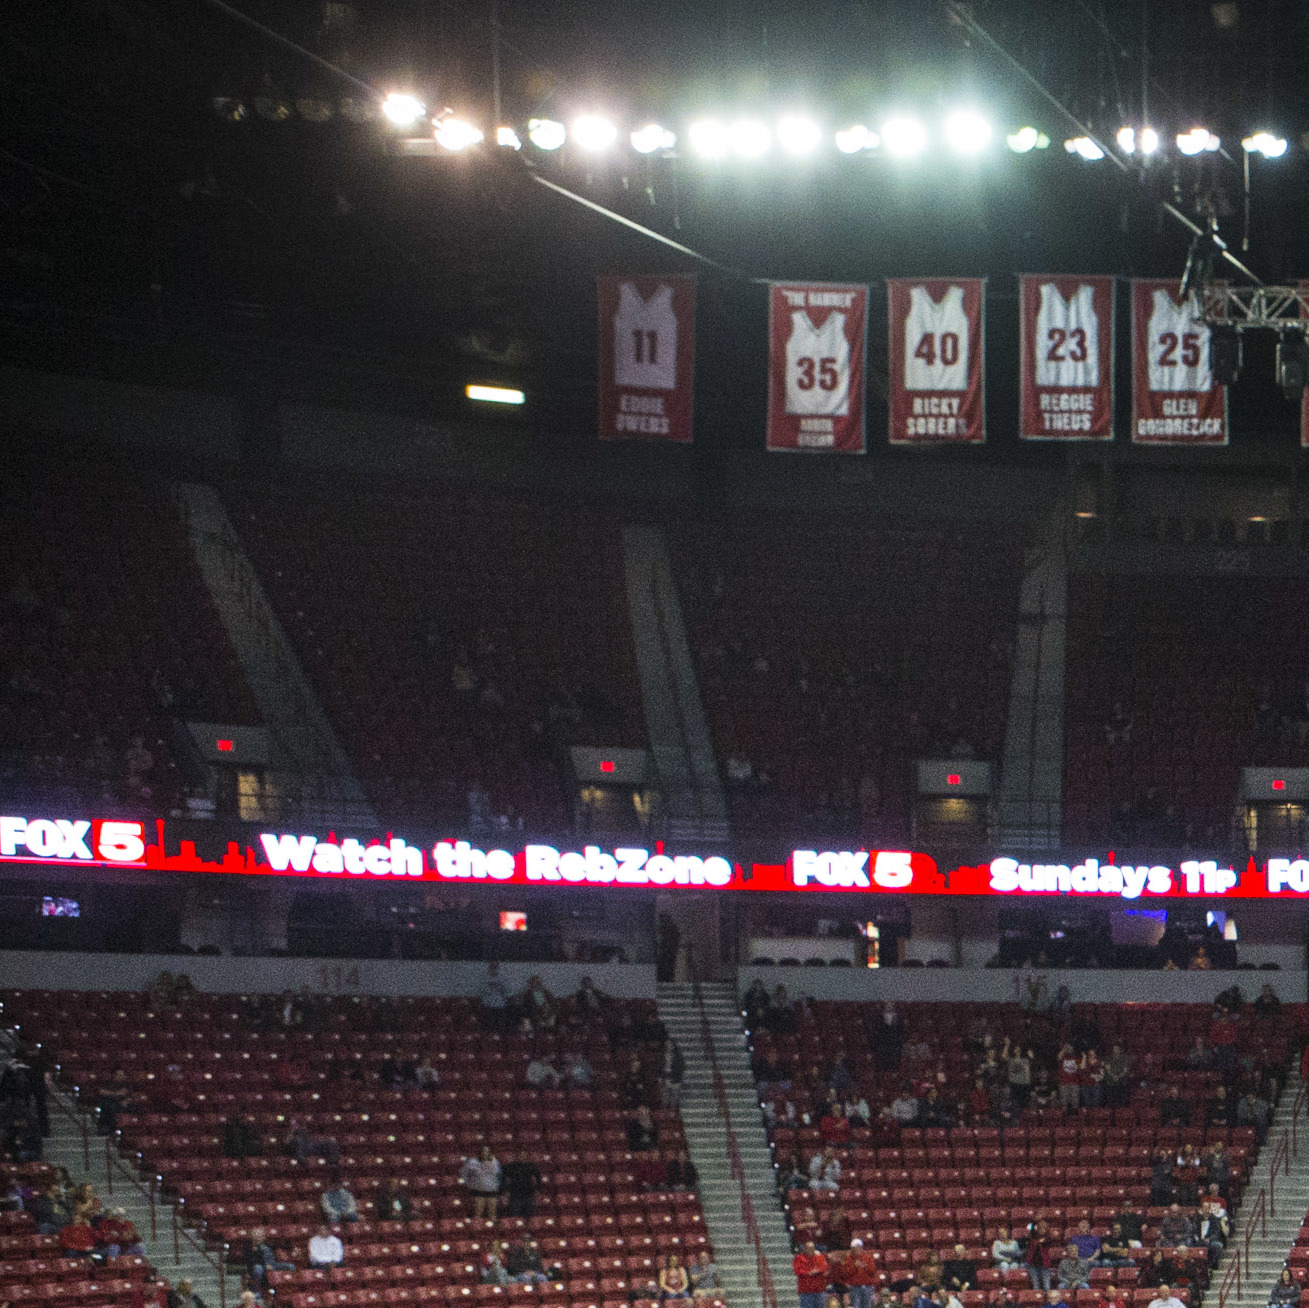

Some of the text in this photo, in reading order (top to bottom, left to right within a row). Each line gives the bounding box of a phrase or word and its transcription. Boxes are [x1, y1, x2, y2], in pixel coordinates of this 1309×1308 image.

[633, 329, 658, 366] 11
[914, 333, 959, 366] 40
[1047, 328, 1087, 362] 23
[1159, 332, 1200, 368] 25
[797, 357, 839, 391] 35
[913, 397, 960, 415] RICKY
[1043, 413, 1092, 430] THEUS
[0, 817, 145, 862] FOX 5
[259, 834, 732, 885] Watch the RebZone
[792, 850, 912, 888] FOX 5
[989, 857, 1171, 898] Sundays
